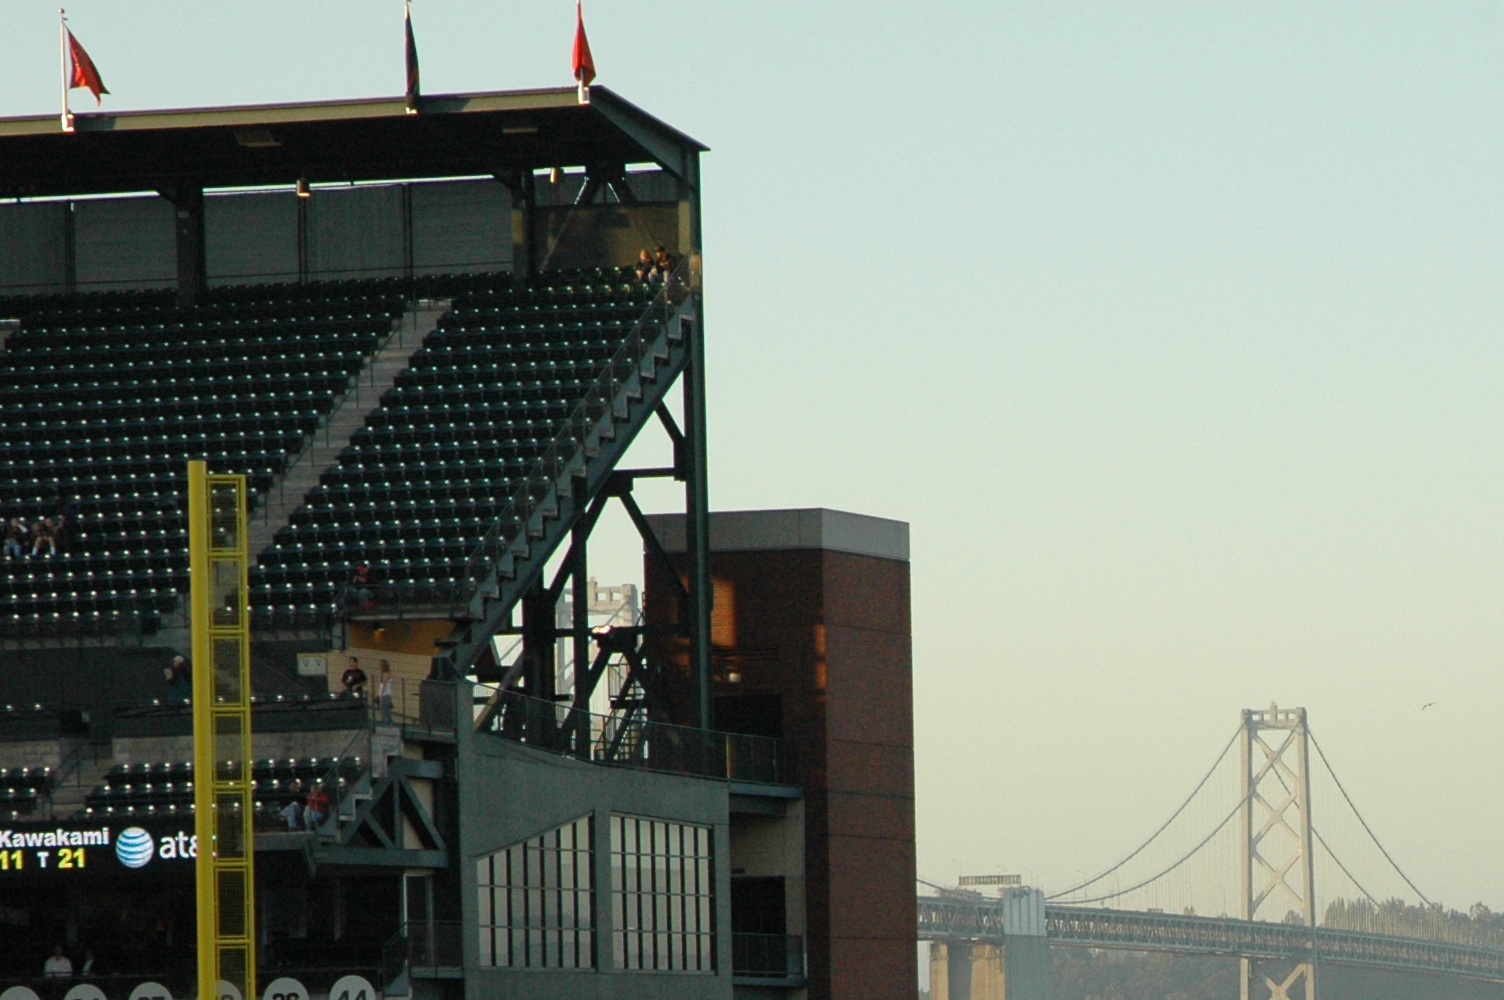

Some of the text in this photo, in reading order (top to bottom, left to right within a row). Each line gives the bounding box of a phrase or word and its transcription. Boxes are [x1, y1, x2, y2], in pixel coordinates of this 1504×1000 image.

[0, 827, 109, 848] Kawakami
[159, 830, 198, 859] at
[36, 851, 49, 868] T
[58, 848, 86, 869] 21
